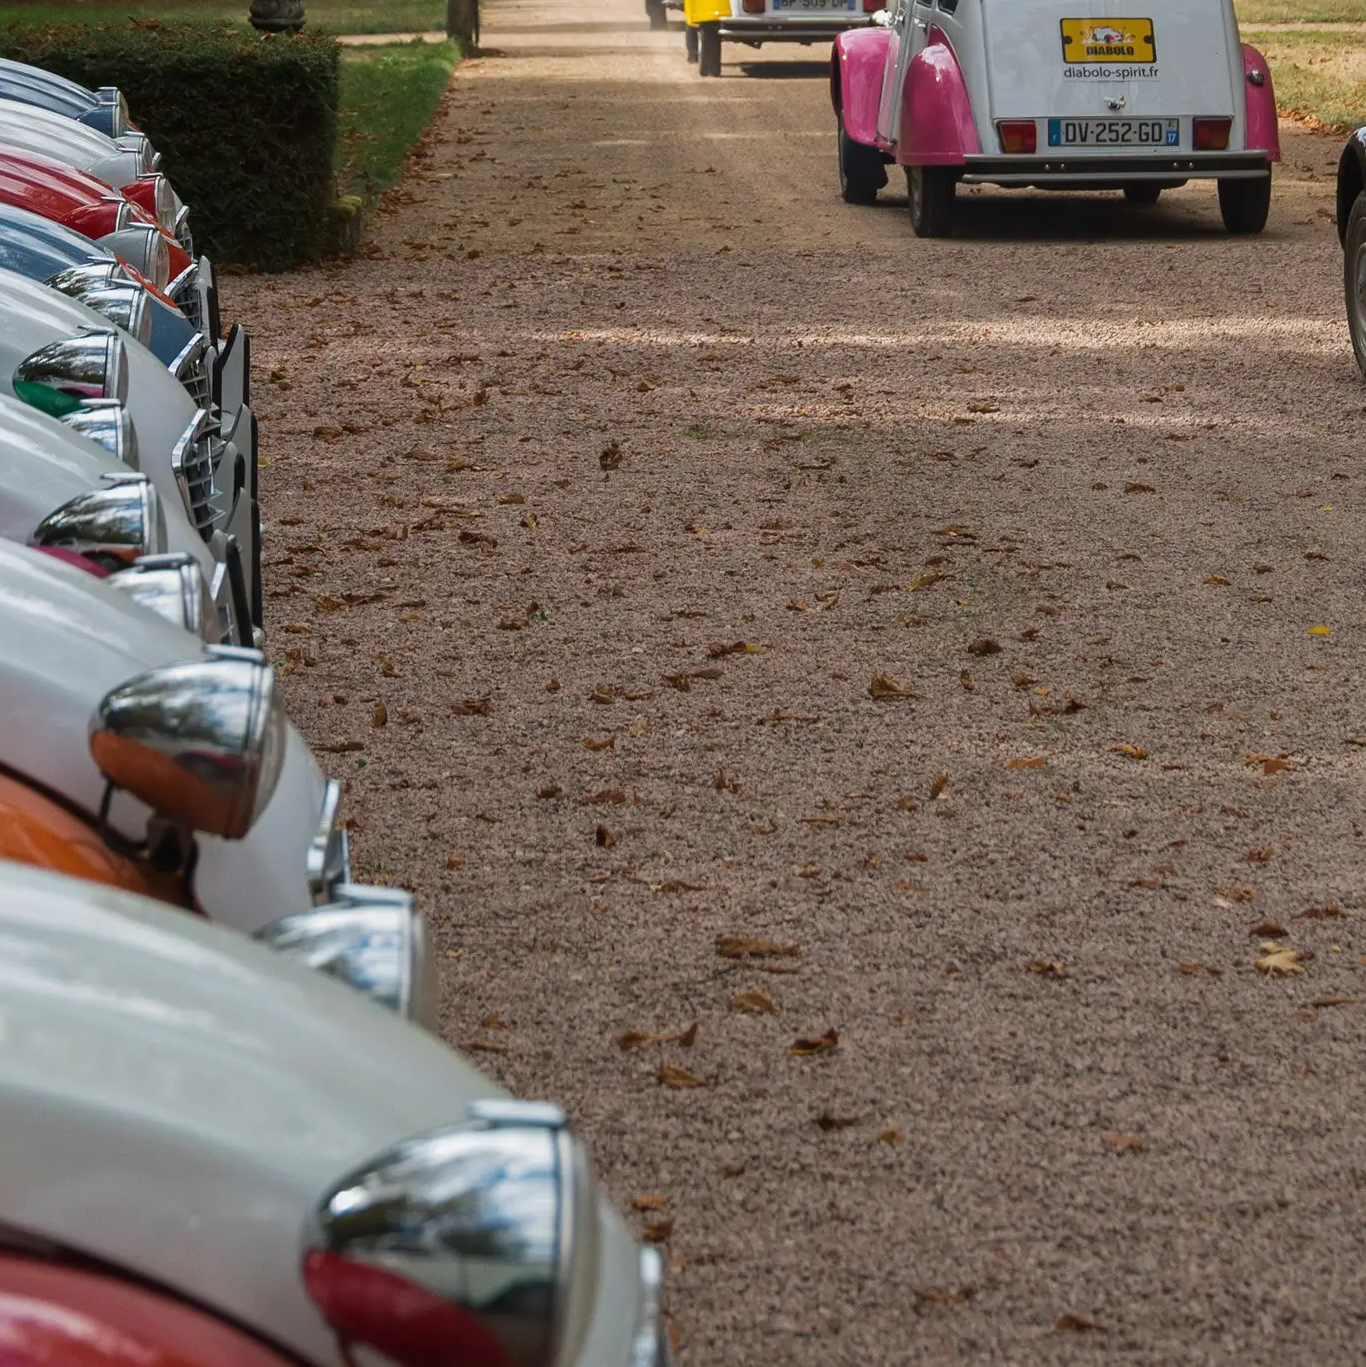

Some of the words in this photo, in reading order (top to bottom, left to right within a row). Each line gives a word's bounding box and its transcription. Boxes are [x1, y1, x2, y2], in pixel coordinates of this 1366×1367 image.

[1086, 46, 1135, 56] DIABOLO
[1064, 66, 1159, 79] diabolo-spirit.fr
[1065, 122, 1163, 143] DV-252-GD
